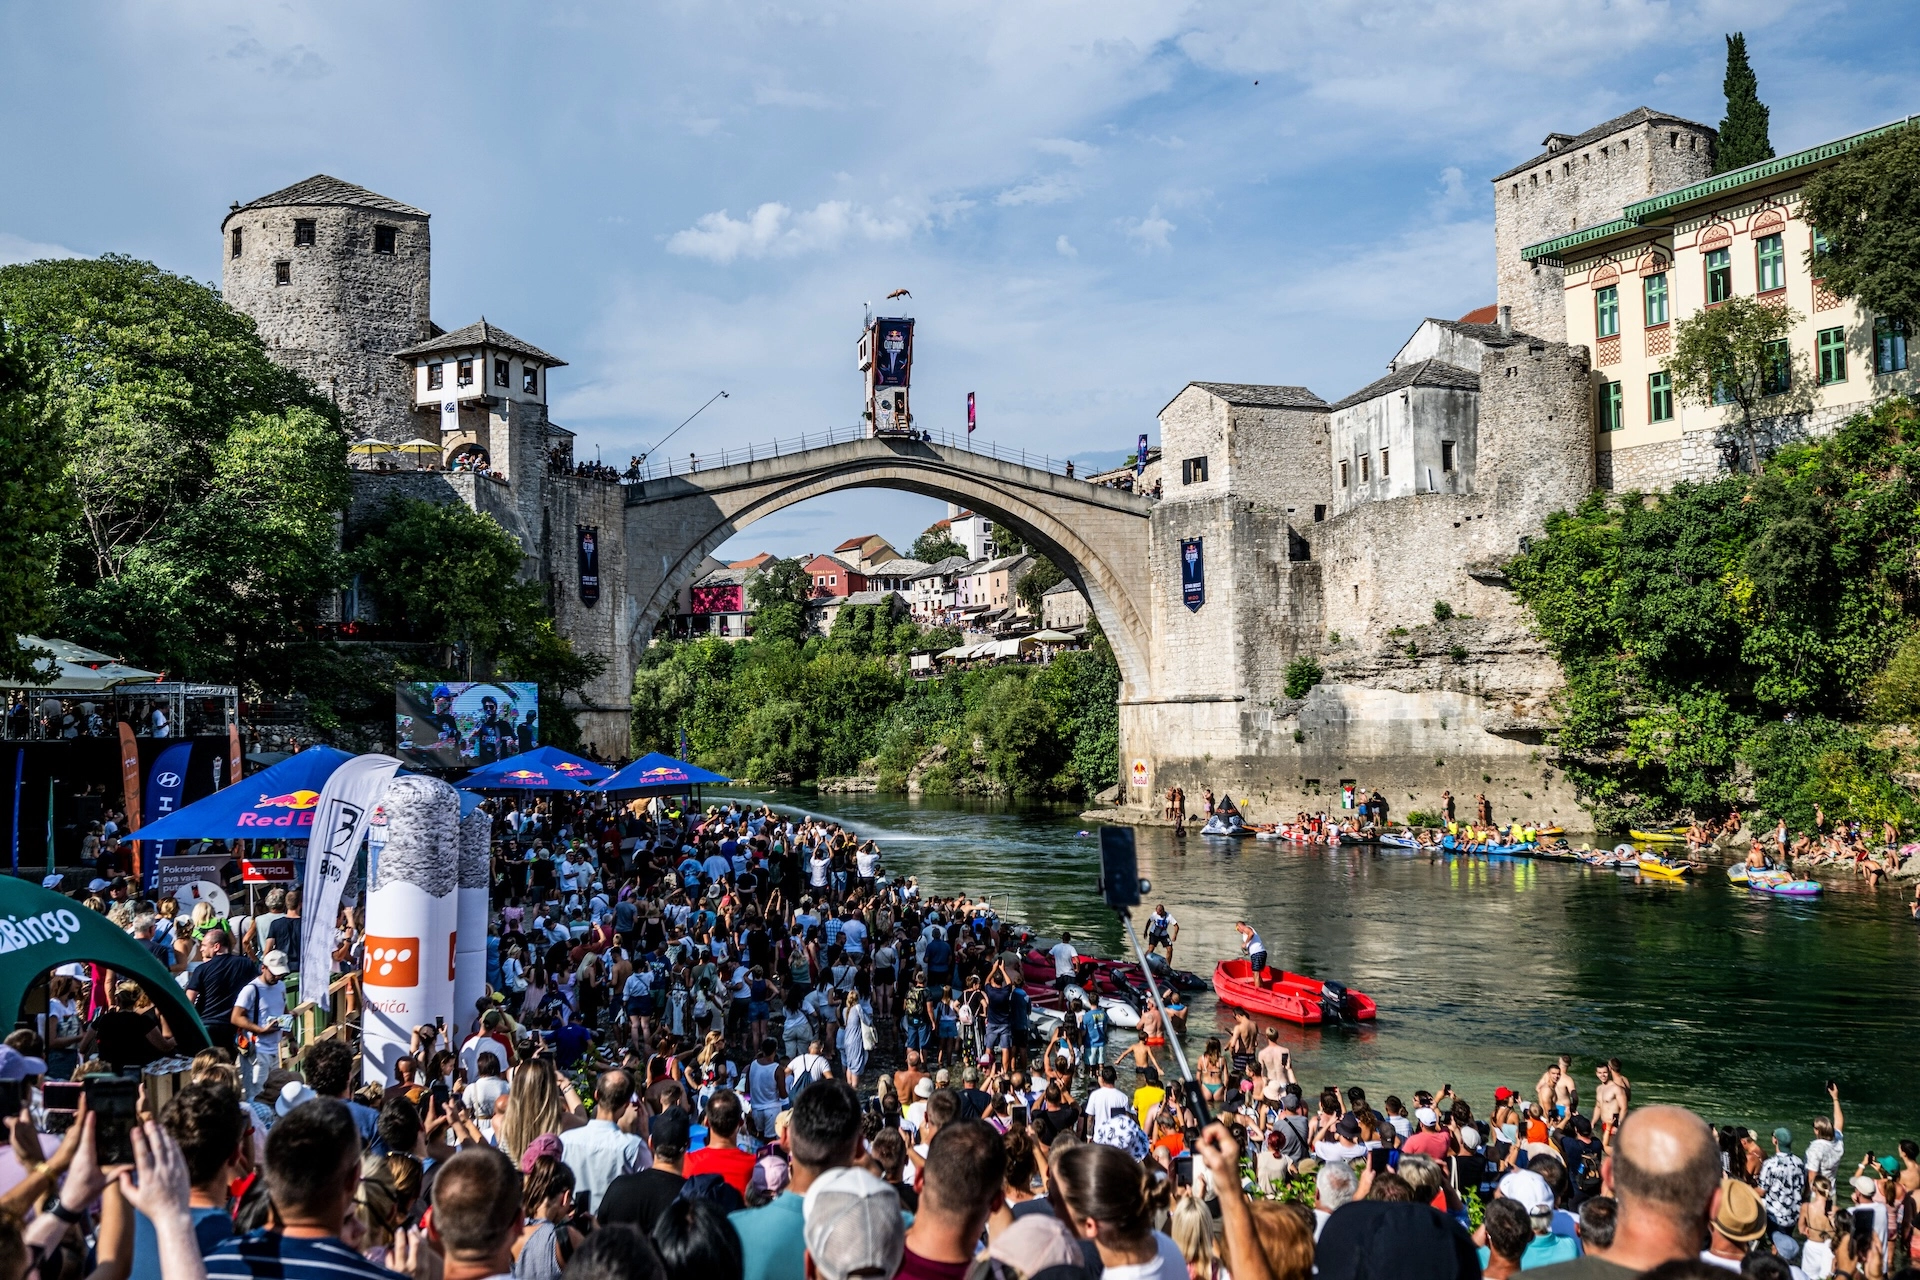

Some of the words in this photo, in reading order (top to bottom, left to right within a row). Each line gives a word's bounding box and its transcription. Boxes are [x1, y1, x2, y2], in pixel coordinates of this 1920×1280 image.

[640, 776, 664, 784] Red
[236, 812, 294, 826] Red
[162, 864, 216, 874] Pokrećemo
[248, 865, 289, 876] PETROL
[0, 908, 80, 950] Bingo
